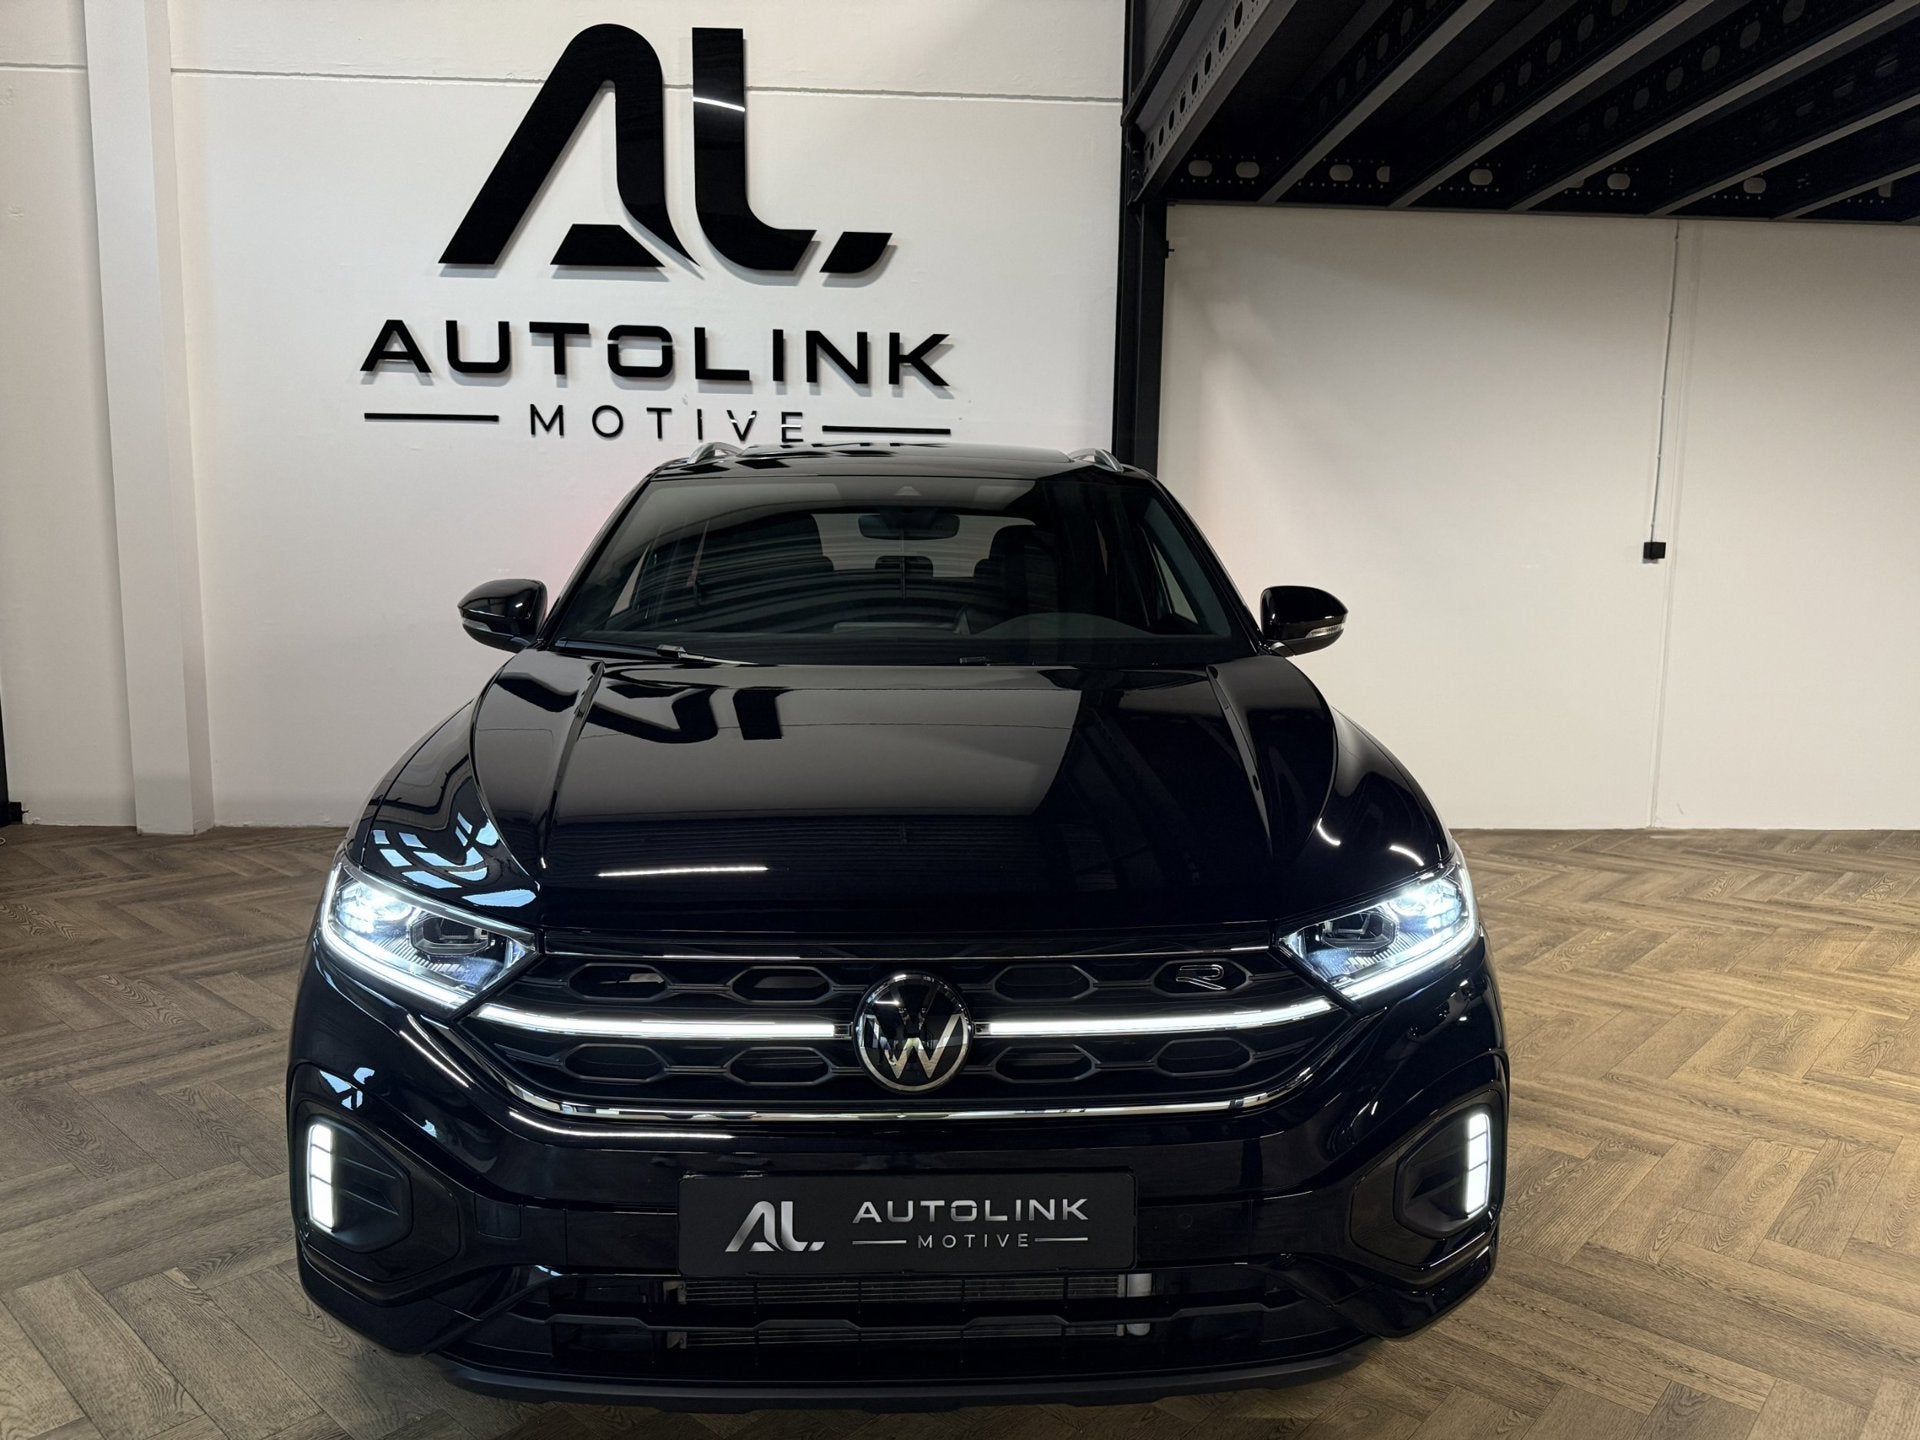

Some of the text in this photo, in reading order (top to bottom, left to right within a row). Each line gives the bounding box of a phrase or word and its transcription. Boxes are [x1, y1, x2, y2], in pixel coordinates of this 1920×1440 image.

[359, 318, 951, 388] AUTOLINK
[529, 403, 805, 444] MOTIVE
[852, 1198, 1090, 1224] AUTOLINK
[917, 1232, 1030, 1249] MOTIVE
